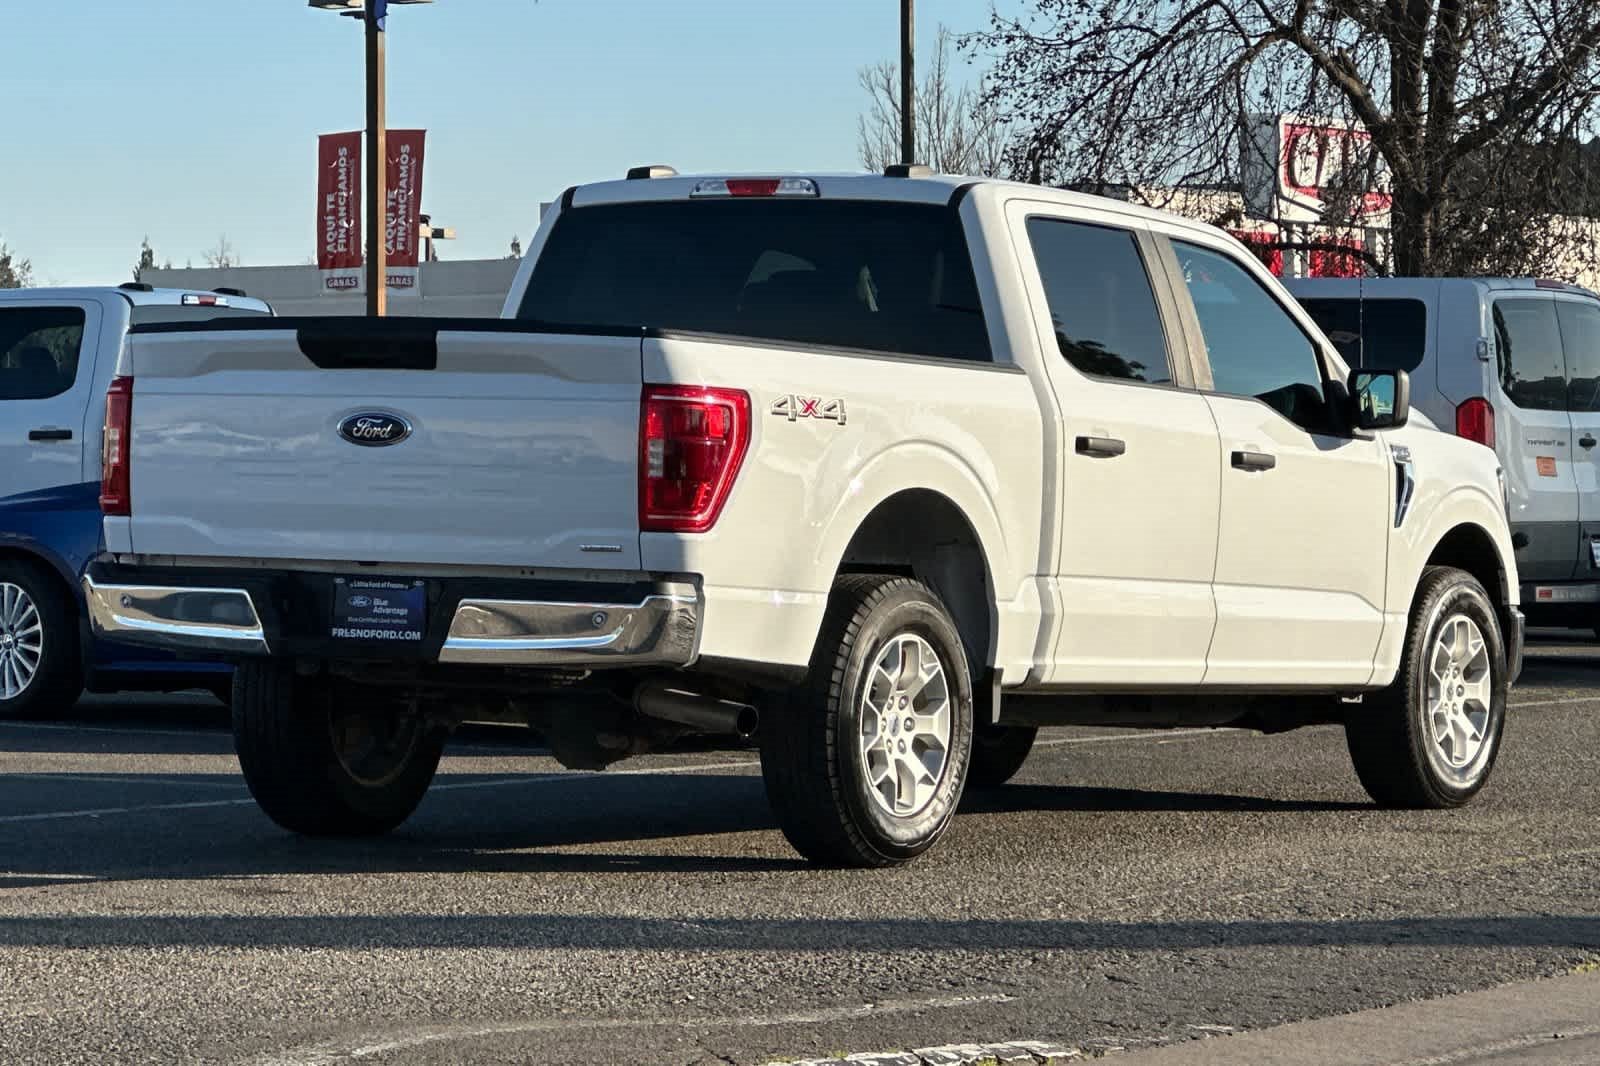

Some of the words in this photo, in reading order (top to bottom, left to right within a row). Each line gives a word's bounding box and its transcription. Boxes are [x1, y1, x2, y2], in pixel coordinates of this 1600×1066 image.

[326, 193, 336, 211] TE
[338, 146, 348, 253] FINANCIAMOS
[386, 190, 397, 209] TE
[396, 144, 411, 251] FINANCIAMOS
[324, 216, 338, 253] AQUÍ
[327, 278, 356, 288] GANAS
[352, 417, 393, 438] Ford
[332, 628, 421, 640] FRESNOFORD.COM
